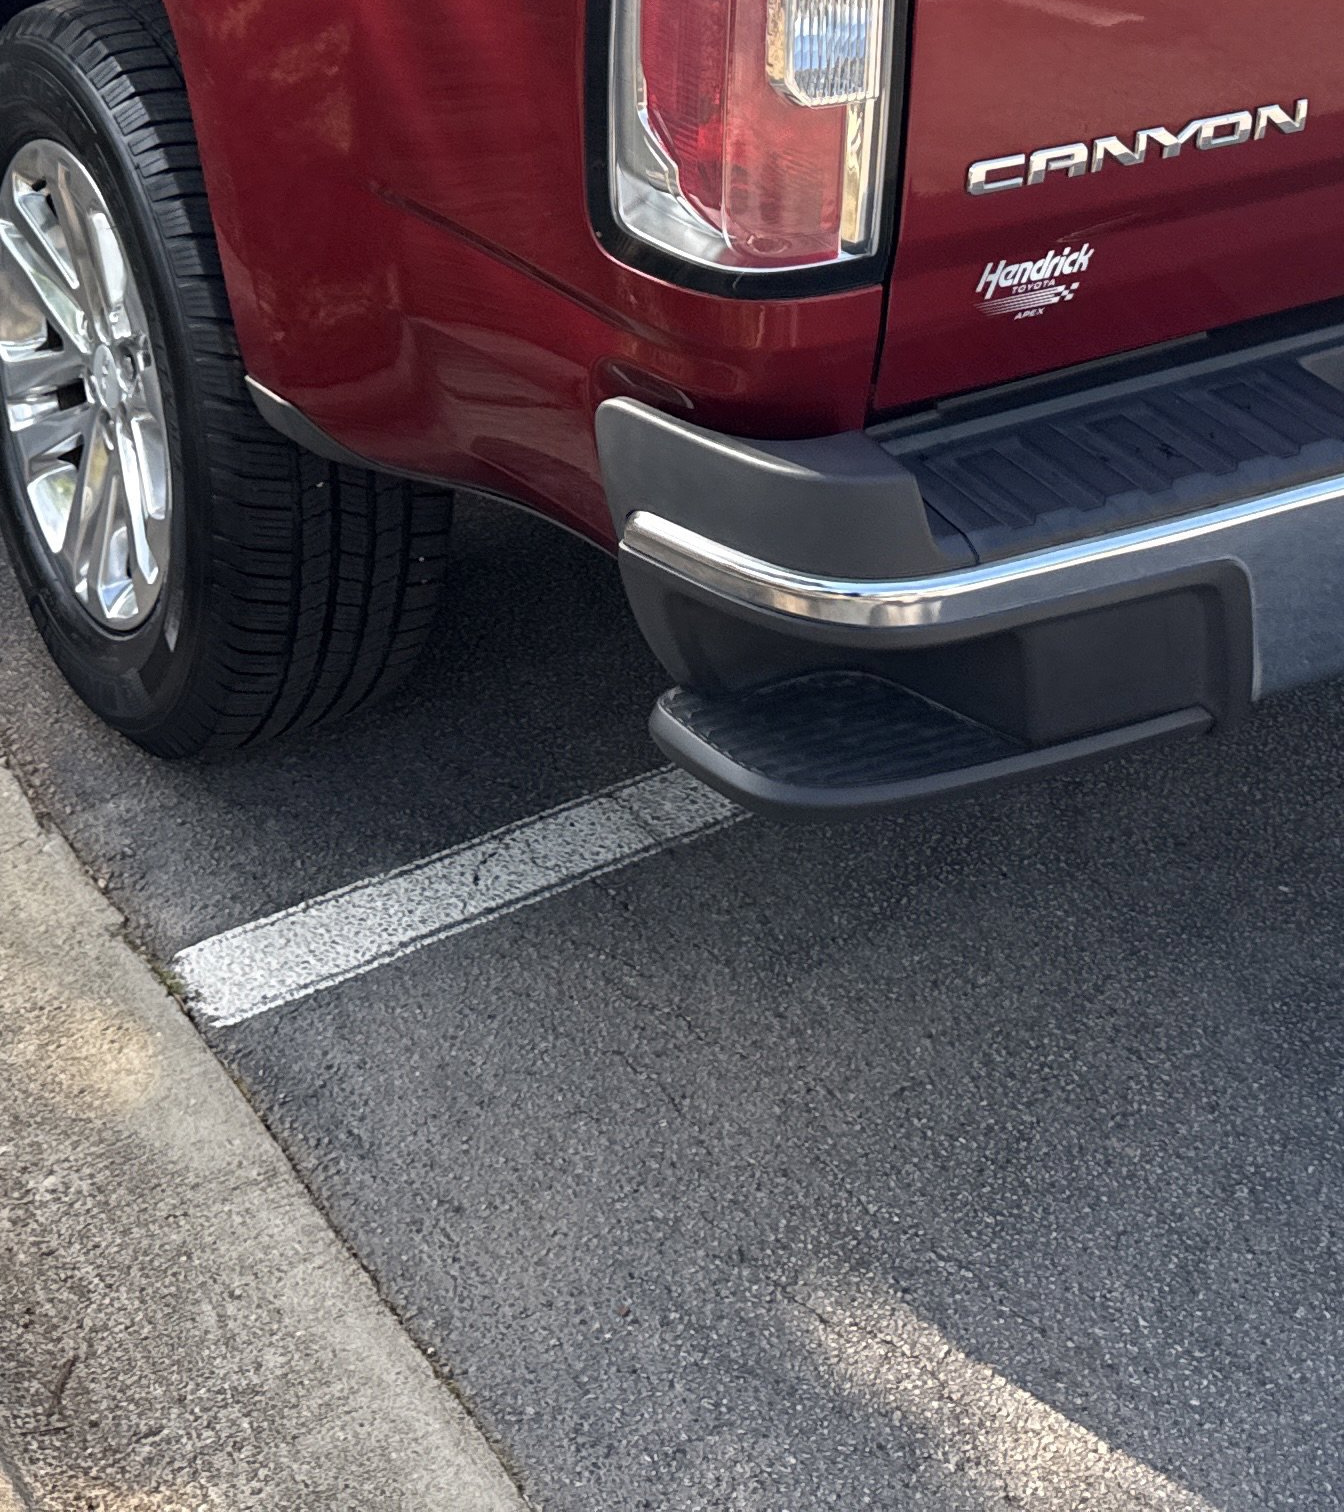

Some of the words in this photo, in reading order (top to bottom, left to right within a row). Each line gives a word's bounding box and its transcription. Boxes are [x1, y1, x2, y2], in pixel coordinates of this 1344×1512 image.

[967, 99, 1309, 196] CANYON
[975, 242, 1095, 300] Hendrick
[1011, 278, 1056, 295] TOYOTA
[1014, 307, 1045, 321] APEX
